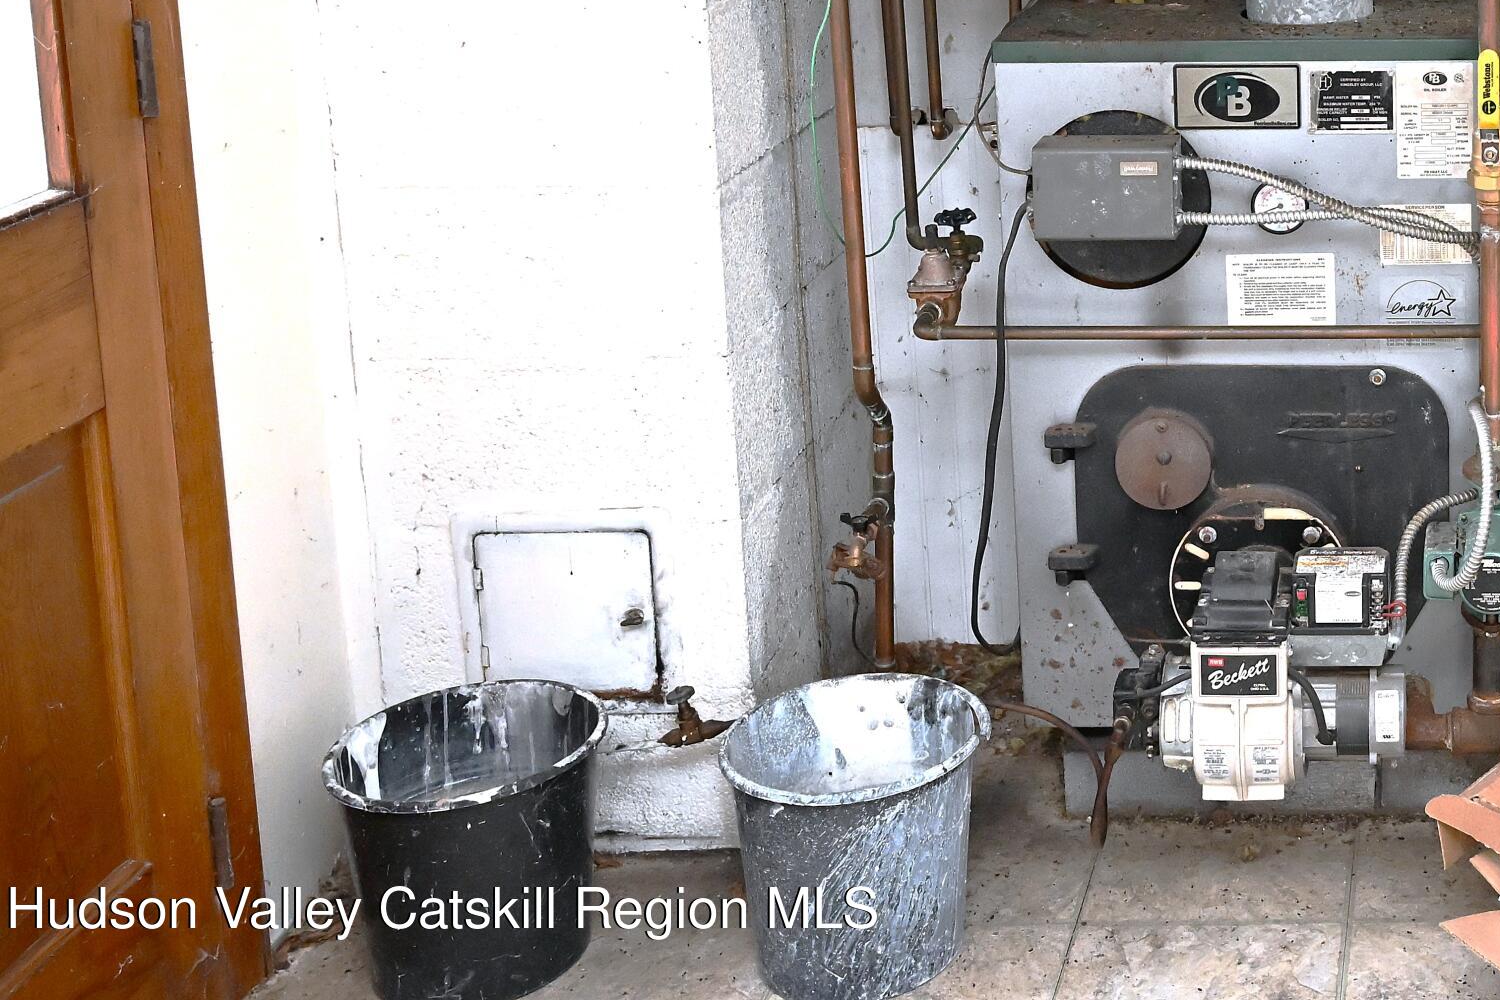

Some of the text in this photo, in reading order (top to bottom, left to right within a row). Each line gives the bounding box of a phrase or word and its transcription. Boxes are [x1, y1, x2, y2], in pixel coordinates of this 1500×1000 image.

[1216, 76, 1252, 116] PB
[1391, 301, 1434, 317] energy
[1208, 658, 1270, 690] Beckett
